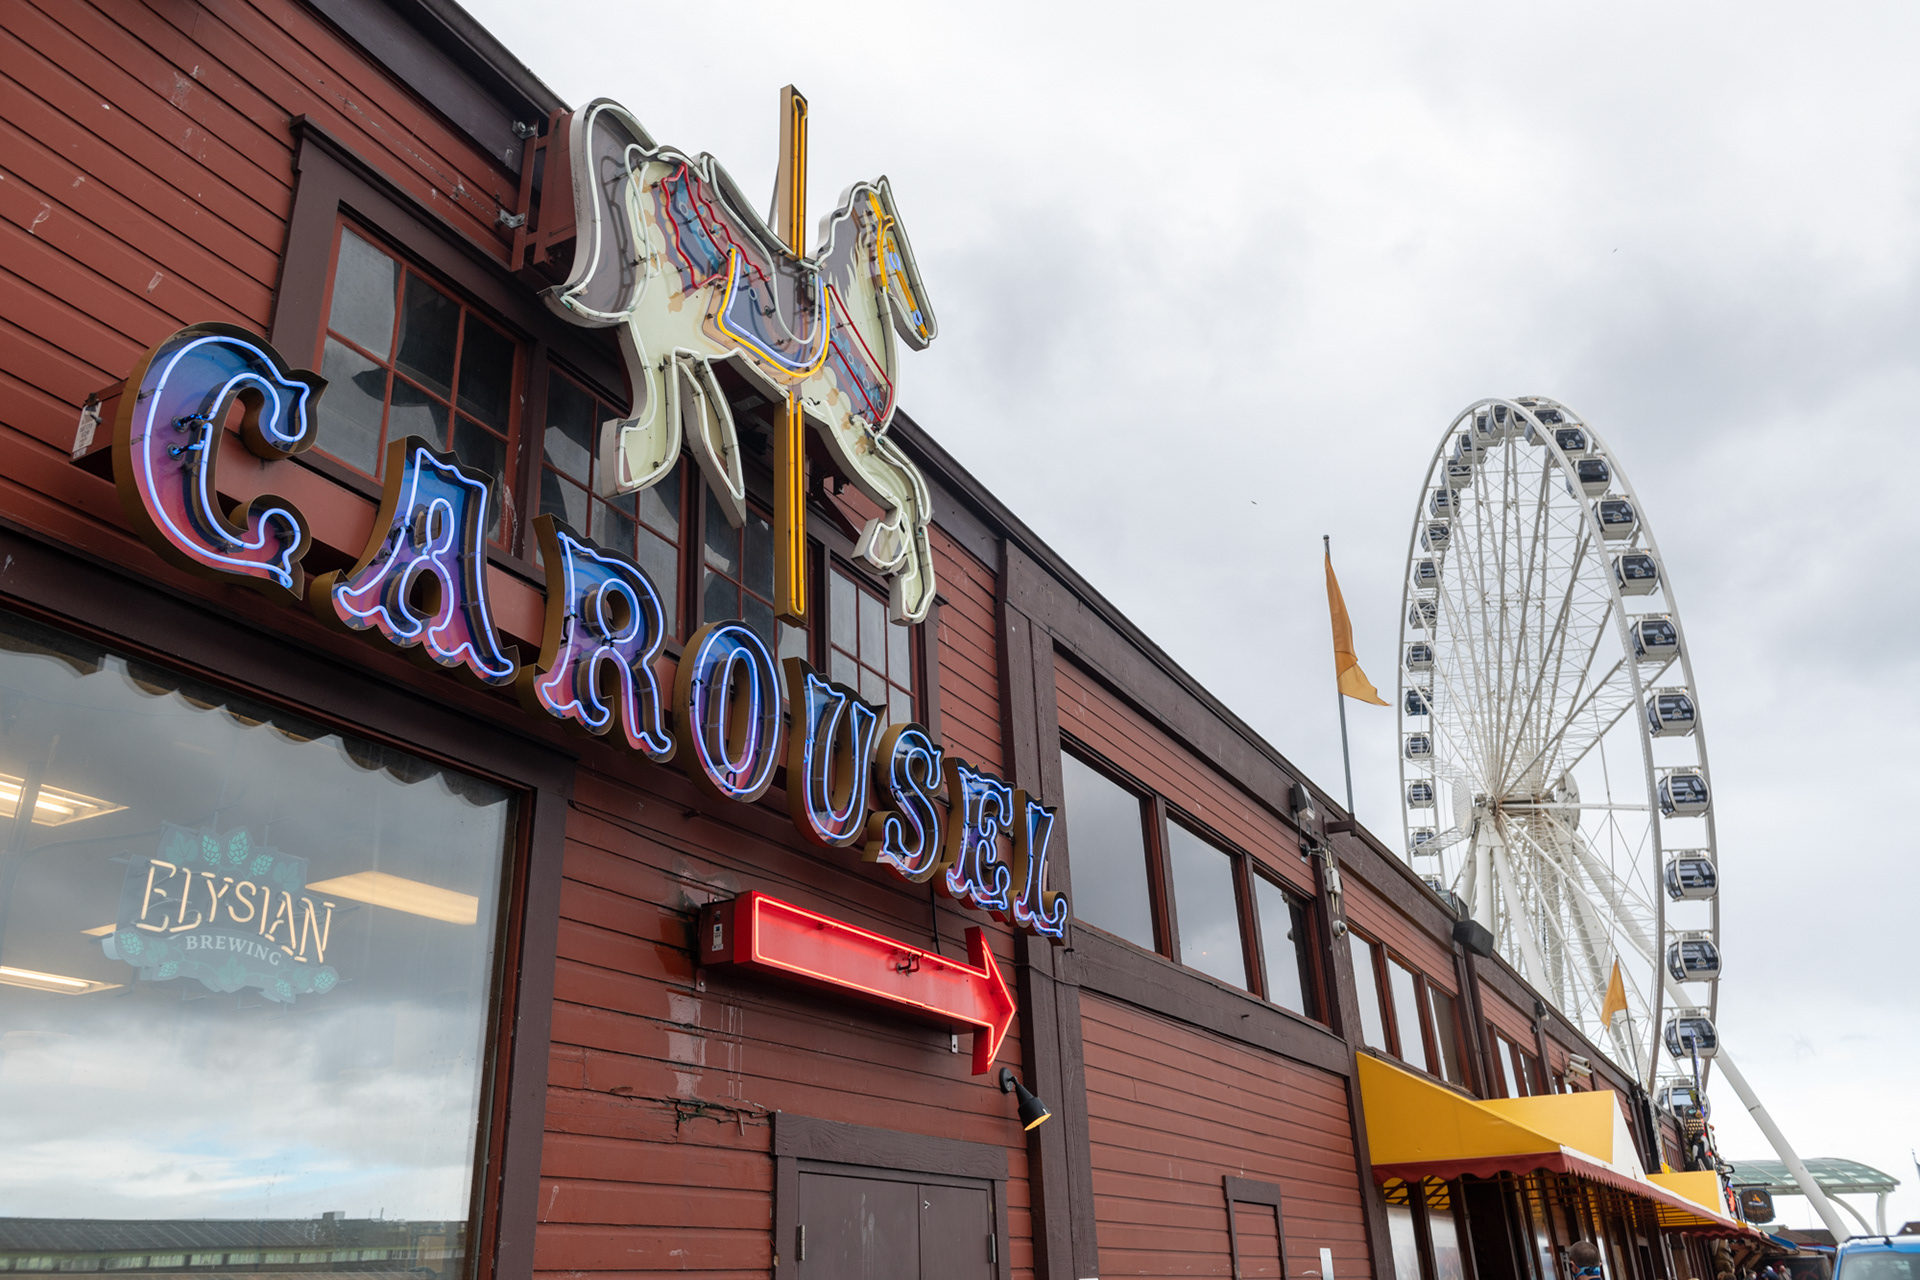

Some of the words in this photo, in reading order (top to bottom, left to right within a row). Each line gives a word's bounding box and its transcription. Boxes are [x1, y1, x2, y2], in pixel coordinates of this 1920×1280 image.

[112, 321, 1071, 943] CAROUSEL
[136, 859, 336, 963] ELYSIAN
[185, 935, 282, 966] BREWING
